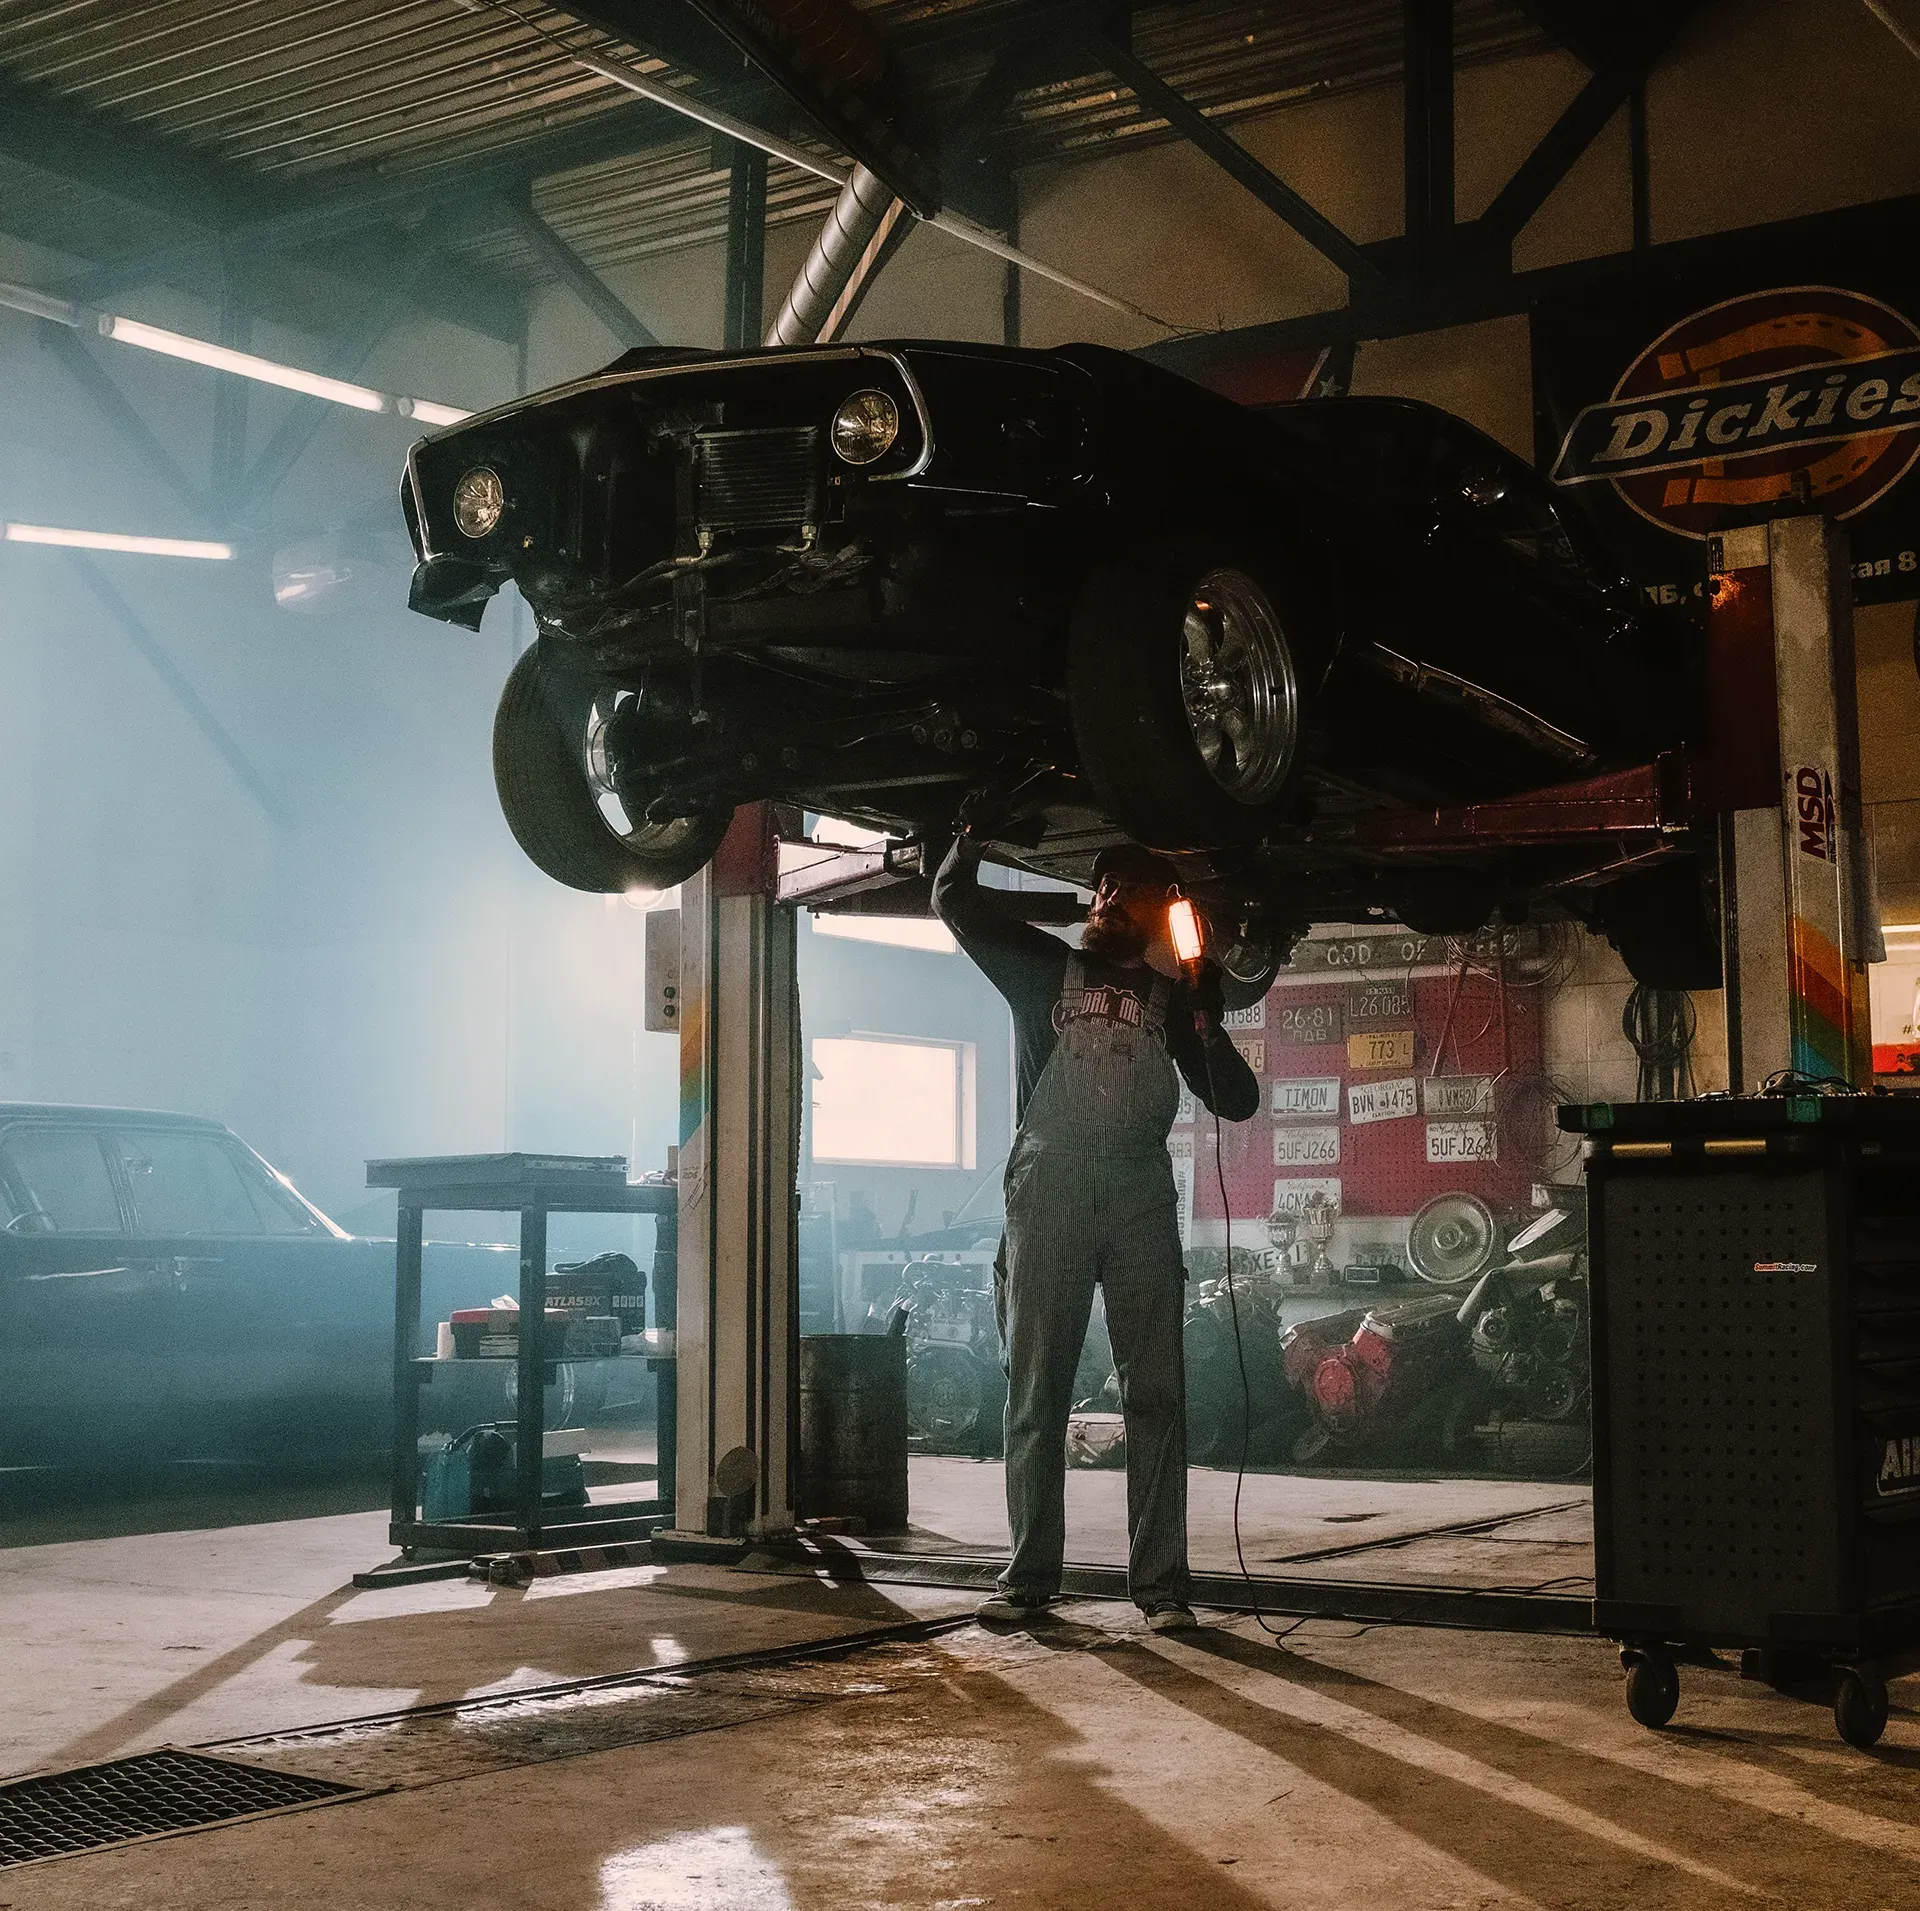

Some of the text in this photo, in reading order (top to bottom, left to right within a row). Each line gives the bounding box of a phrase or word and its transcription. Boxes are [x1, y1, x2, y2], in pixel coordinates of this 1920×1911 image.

[1591, 373, 1920, 463] Dickies
[1797, 767, 1826, 860] MSD
[1369, 1040, 1394, 1060] 773
[1285, 1087, 1328, 1108] TIMON
[1352, 1088, 1413, 1115] BVN 1475
[1278, 1141, 1336, 1160] 5UFJ266
